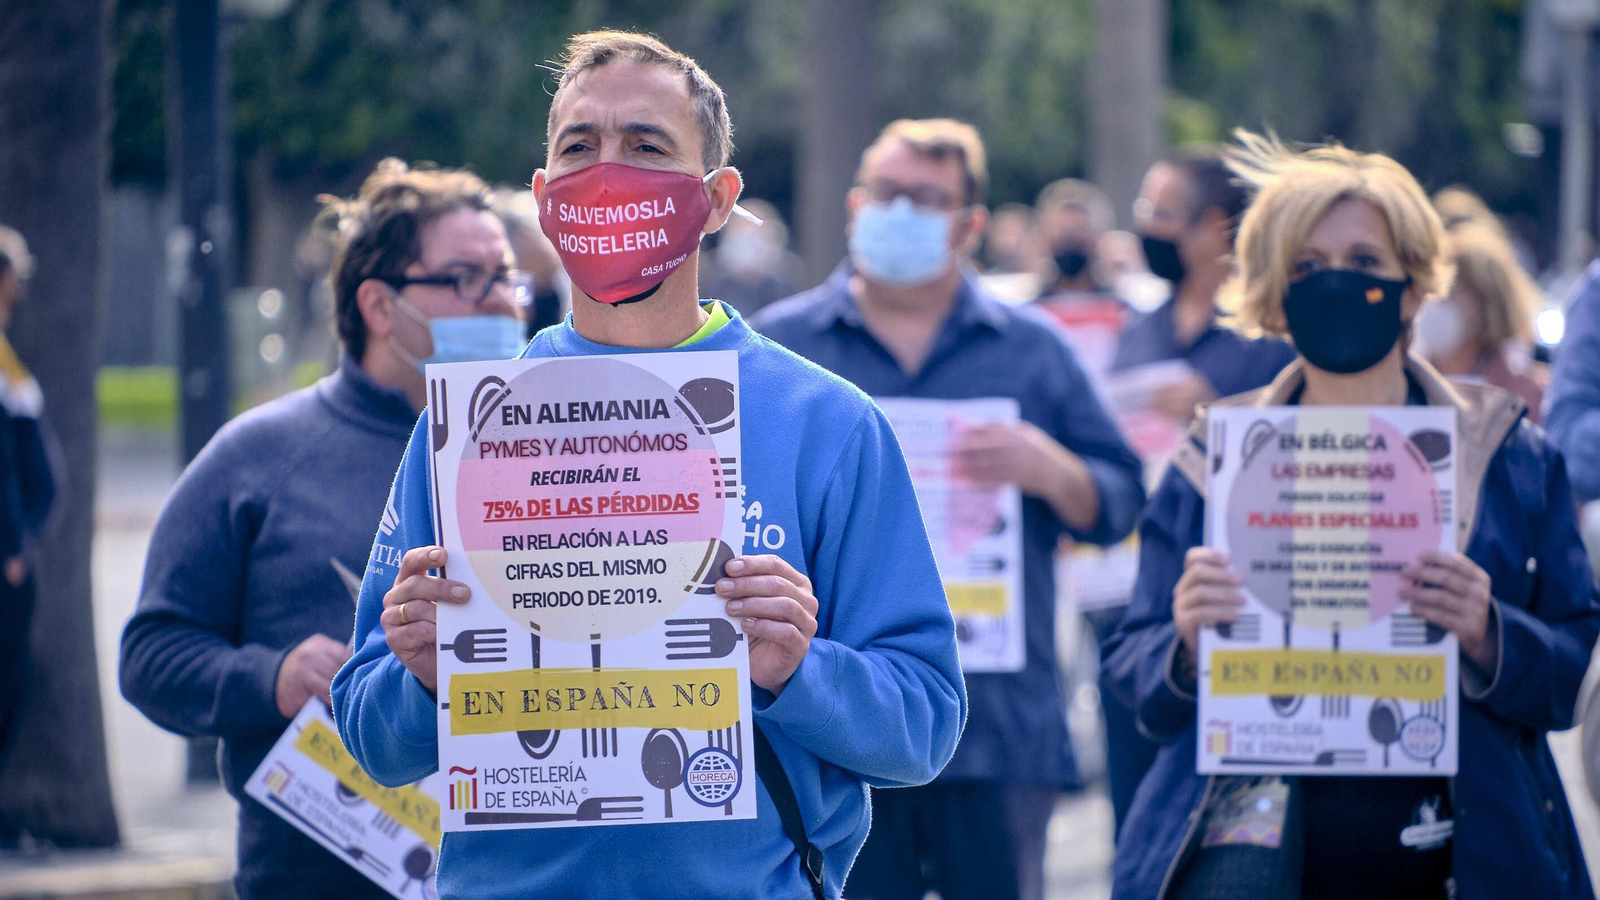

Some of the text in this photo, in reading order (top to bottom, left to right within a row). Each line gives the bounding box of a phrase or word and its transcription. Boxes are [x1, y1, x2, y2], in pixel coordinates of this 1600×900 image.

[559, 197, 676, 225] SALVEMOSLA
[559, 228, 669, 254] HOSTELERIA
[641, 254, 687, 277] CASA TUCHO
[501, 398, 671, 426] EN ALEMANIA
[480, 430, 688, 460] PYMES Y AUTONÓMOS
[1279, 429, 1387, 450] EN BÉLGICA
[530, 463, 641, 486] RECIBIRÁN EL
[1271, 463, 1395, 480] LAS EMPRESAS
[483, 490, 700, 520] 75% DE LAS PÉRDIDAS
[1248, 512, 1419, 528] PLANES ESPECIALES
[503, 529, 668, 551] EN RELACIÓN A LAS
[506, 558, 667, 581] CIFRAS DEL MISMO
[512, 588, 662, 609] PERIODO DE 2019.
[1222, 659, 1433, 684] EN ESPAÑA NO
[462, 681, 721, 716] EN ESPAÑA NO
[484, 760, 587, 785] HOSTELERÍA
[692, 772, 734, 782] HORECA
[485, 792, 506, 808] DE
